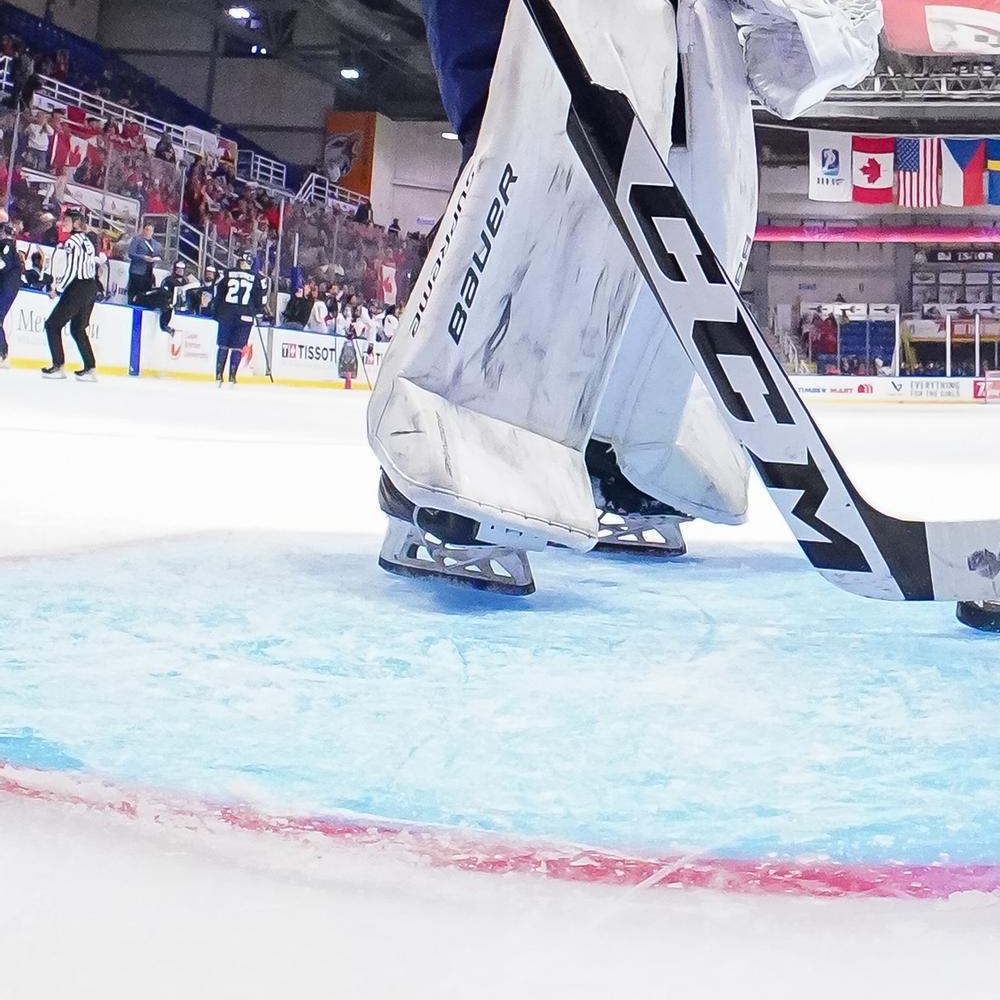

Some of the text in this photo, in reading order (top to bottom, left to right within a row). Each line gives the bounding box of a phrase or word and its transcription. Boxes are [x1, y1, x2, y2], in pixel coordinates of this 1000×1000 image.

[225, 278, 254, 305] 27
[447, 162, 519, 346] BAUER
[298, 344, 336, 362] TISSOT
[627, 184, 874, 574] CCM
